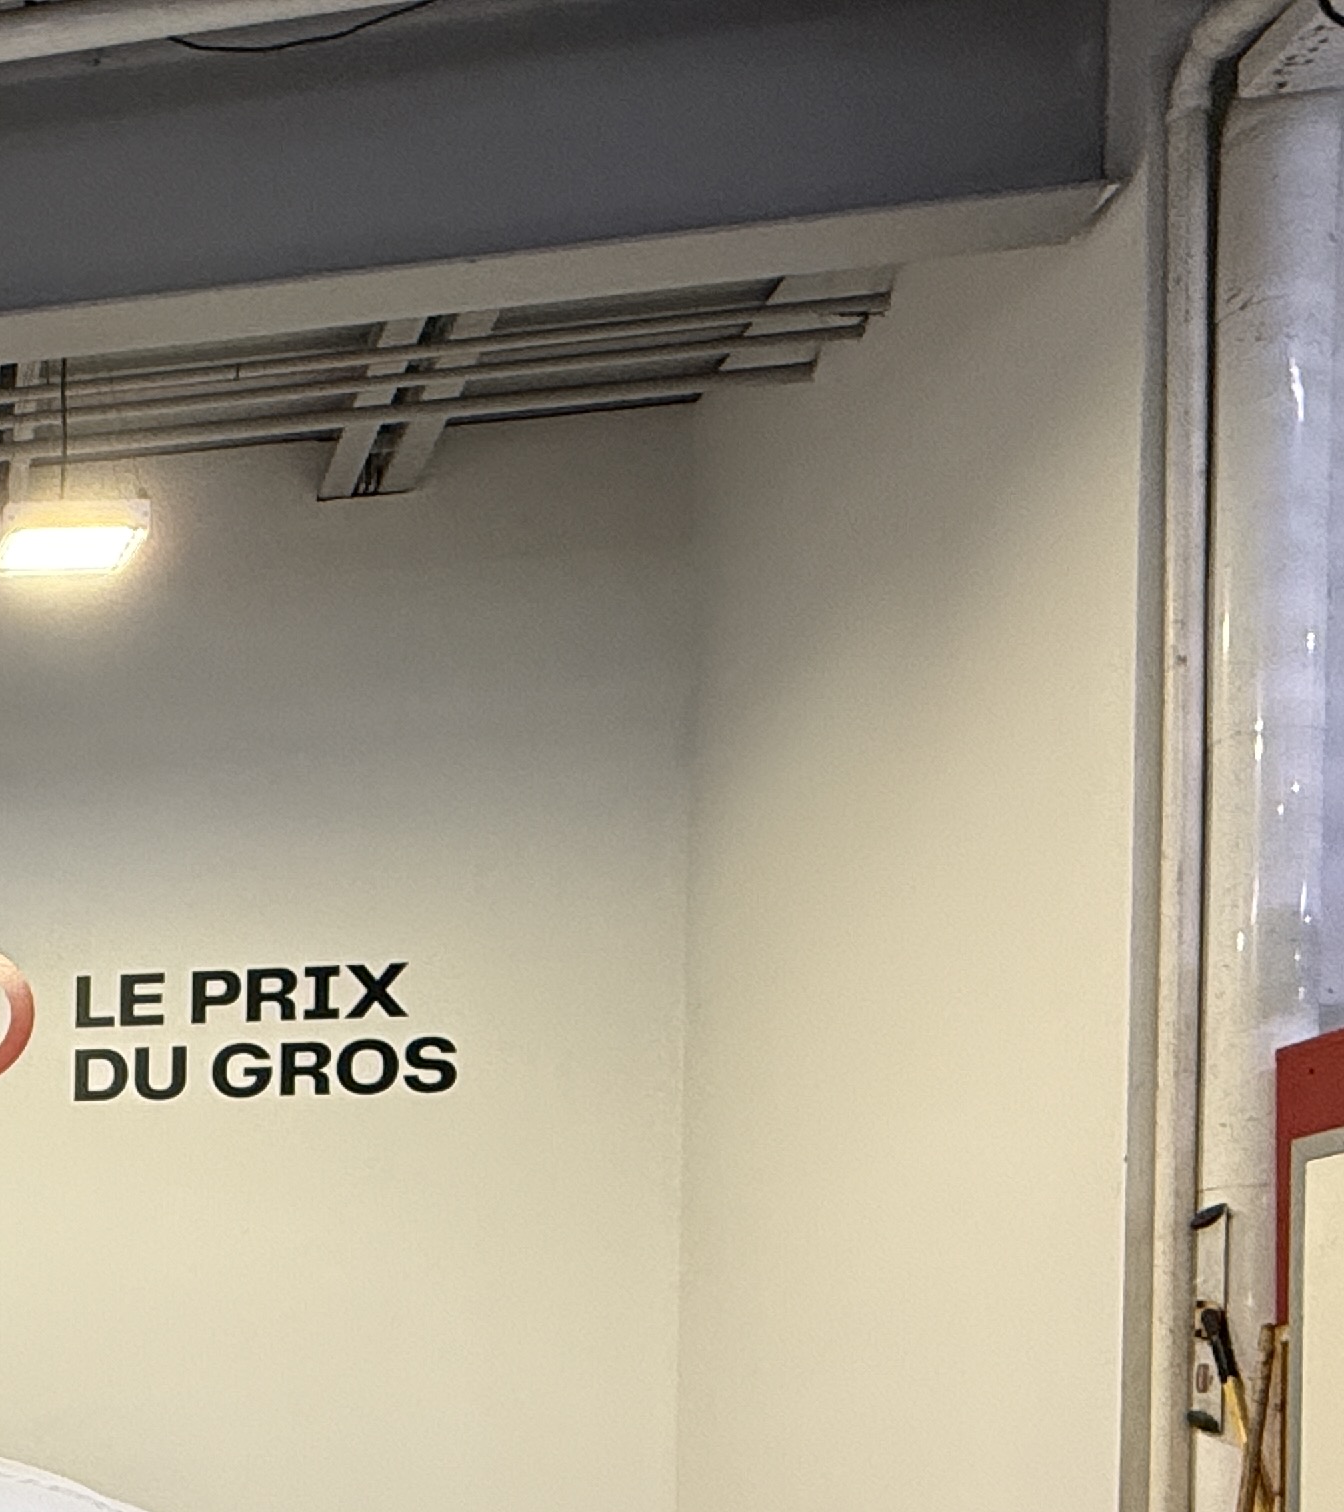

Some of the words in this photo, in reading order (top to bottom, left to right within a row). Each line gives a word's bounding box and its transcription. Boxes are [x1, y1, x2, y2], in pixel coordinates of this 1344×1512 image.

[75, 971, 165, 1029] LE
[190, 962, 409, 1025] PRIX
[73, 1045, 188, 1102] DU
[211, 1036, 458, 1099] GROS
